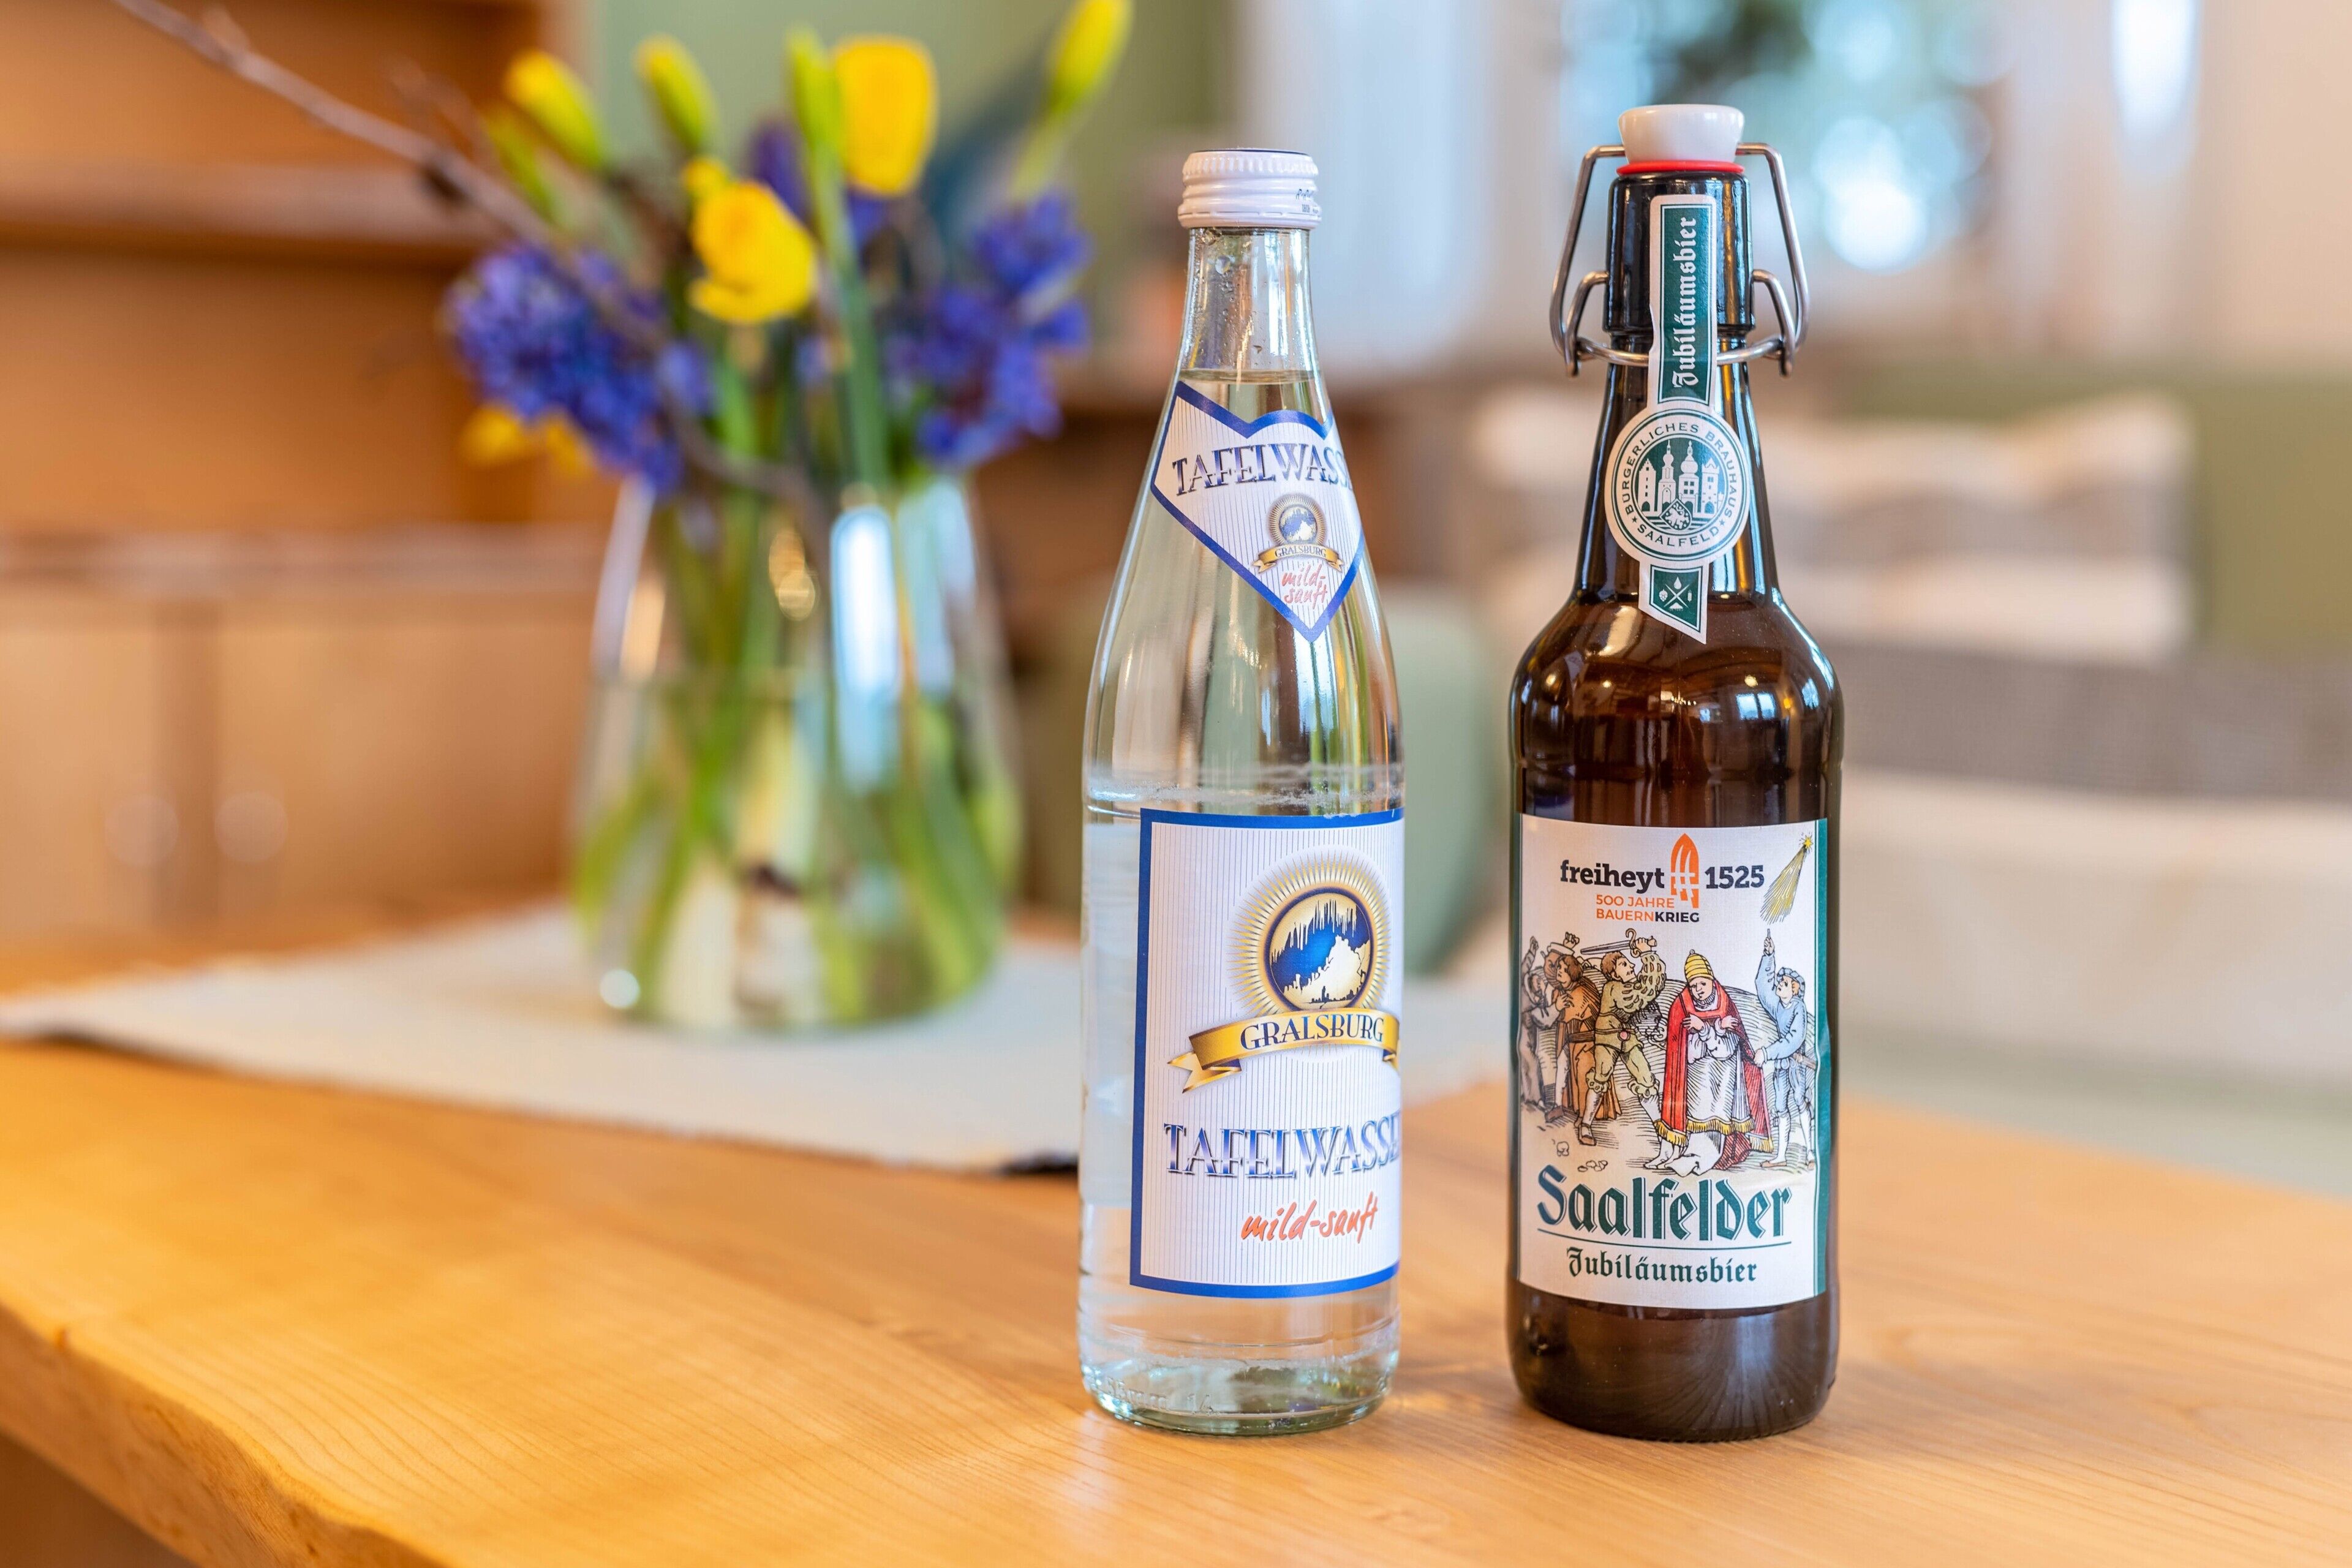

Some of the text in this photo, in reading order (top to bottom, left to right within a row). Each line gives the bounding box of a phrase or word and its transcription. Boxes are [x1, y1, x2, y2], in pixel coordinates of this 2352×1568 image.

[1672, 217, 1698, 387] Jubiläumsbier
[1172, 443, 1352, 496] TAFELWASS
[1705, 431, 1736, 518] BRAUHAUS
[1275, 545, 1327, 558] GRALSBURG
[1637, 525, 1719, 547] SAALFELD
[1283, 581, 1328, 610] sanft
[1560, 860, 1765, 894] freiheyt 1525
[1596, 894, 1675, 908] 500 JAHRE
[1596, 908, 1700, 922] BAUERNKRIEG
[1240, 1014, 1385, 1050] GRALSBURG
[1240, 1191, 1379, 1243] mild-sanft
[1537, 1164, 1792, 1242] Saalfelder
[1567, 1246, 1757, 1283] Jubiläumsbier
